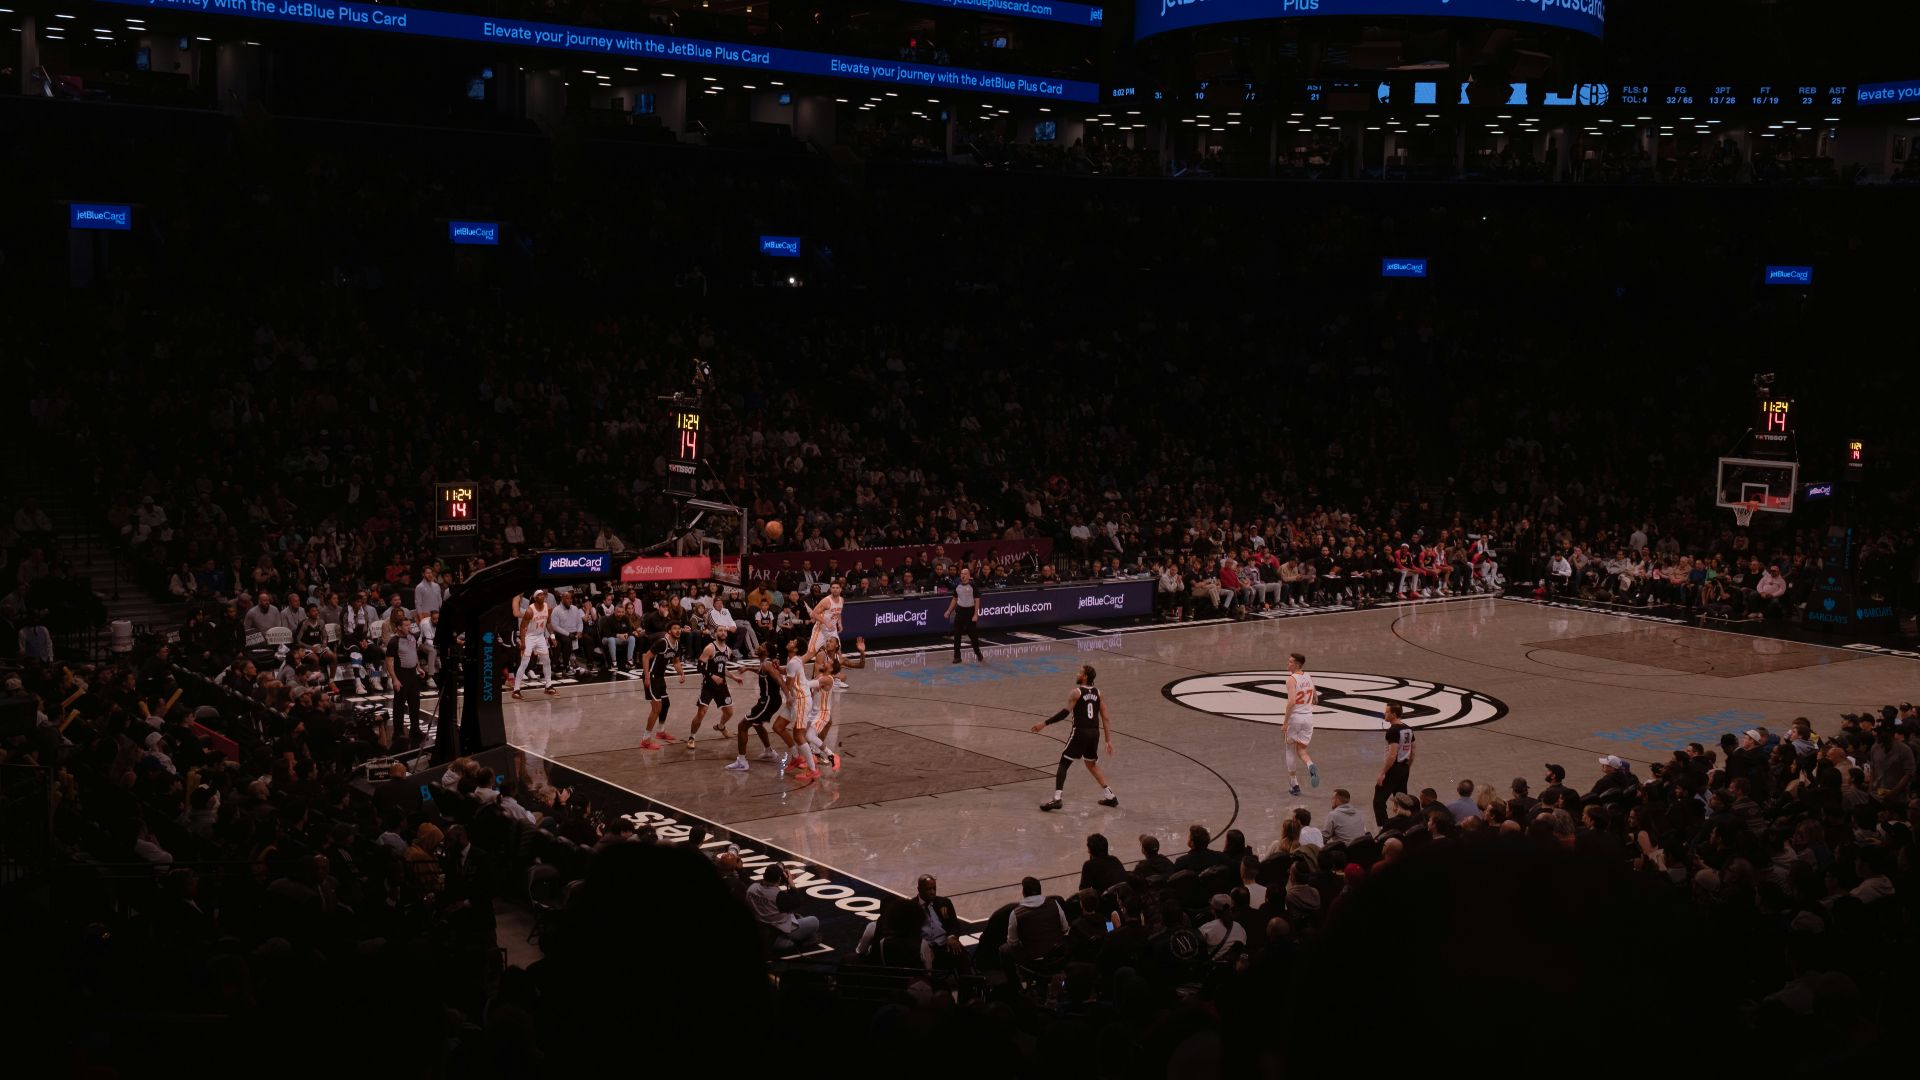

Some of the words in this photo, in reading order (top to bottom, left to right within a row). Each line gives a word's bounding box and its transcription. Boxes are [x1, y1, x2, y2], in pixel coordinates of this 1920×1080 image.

[951, 0, 1051, 15] uepluscard.com
[1283, 0, 1320, 11] Plus
[214, 0, 246, 9] with
[250, 0, 275, 12] the
[279, 1, 334, 18] JetBlue
[339, 7, 368, 22] Plus
[372, 12, 407, 26] Card
[484, 22, 531, 39] Elevate
[535, 29, 564, 44] your
[566, 31, 612, 50] journey
[616, 36, 642, 51] with
[645, 39, 664, 53] the
[667, 42, 712, 58] JetBlue
[715, 47, 739, 61] Plus
[741, 50, 770, 64] Card
[831, 60, 870, 74] Elevate
[871, 66, 895, 79] your
[896, 66, 935, 84] journey
[937, 71, 959, 85] with
[961, 72, 977, 86] the
[979, 75, 1015, 90] JetBlue
[1018, 79, 1037, 92] Plus
[1039, 81, 1063, 95] Card
[1112, 88, 1124, 96] 8:02
[1125, 88, 1135, 96] PM
[1623, 86, 1641, 94] FLS:
[1643, 86, 1649, 94] 0
[1674, 86, 1687, 94] FG
[1715, 86, 1732, 94] 3PT
[1760, 86, 1772, 94] FT
[1799, 86, 1816, 94] REB
[1829, 86, 1846, 94] AST
[1857, 87, 1895, 101] levate
[1898, 86, 1920, 100] you
[1763, 401, 1788, 413] 11:24
[677, 412, 700, 431] 11:24
[1767, 412, 1786, 432] 14
[681, 430, 697, 460] 14
[446, 488, 472, 501] 11:24
[452, 502, 467, 518] 14
[449, 523, 477, 532] TISSOT
[549, 557, 602, 570] jetBlueCard
[748, 569, 771, 581] TAR
[1078, 594, 1124, 608] jetBlueCard
[977, 602, 1052, 617] uecardplus.com
[875, 609, 928, 626] jetBlueCard
[483, 646, 494, 702] BARCLAYS
[1295, 689, 1314, 705] 27
